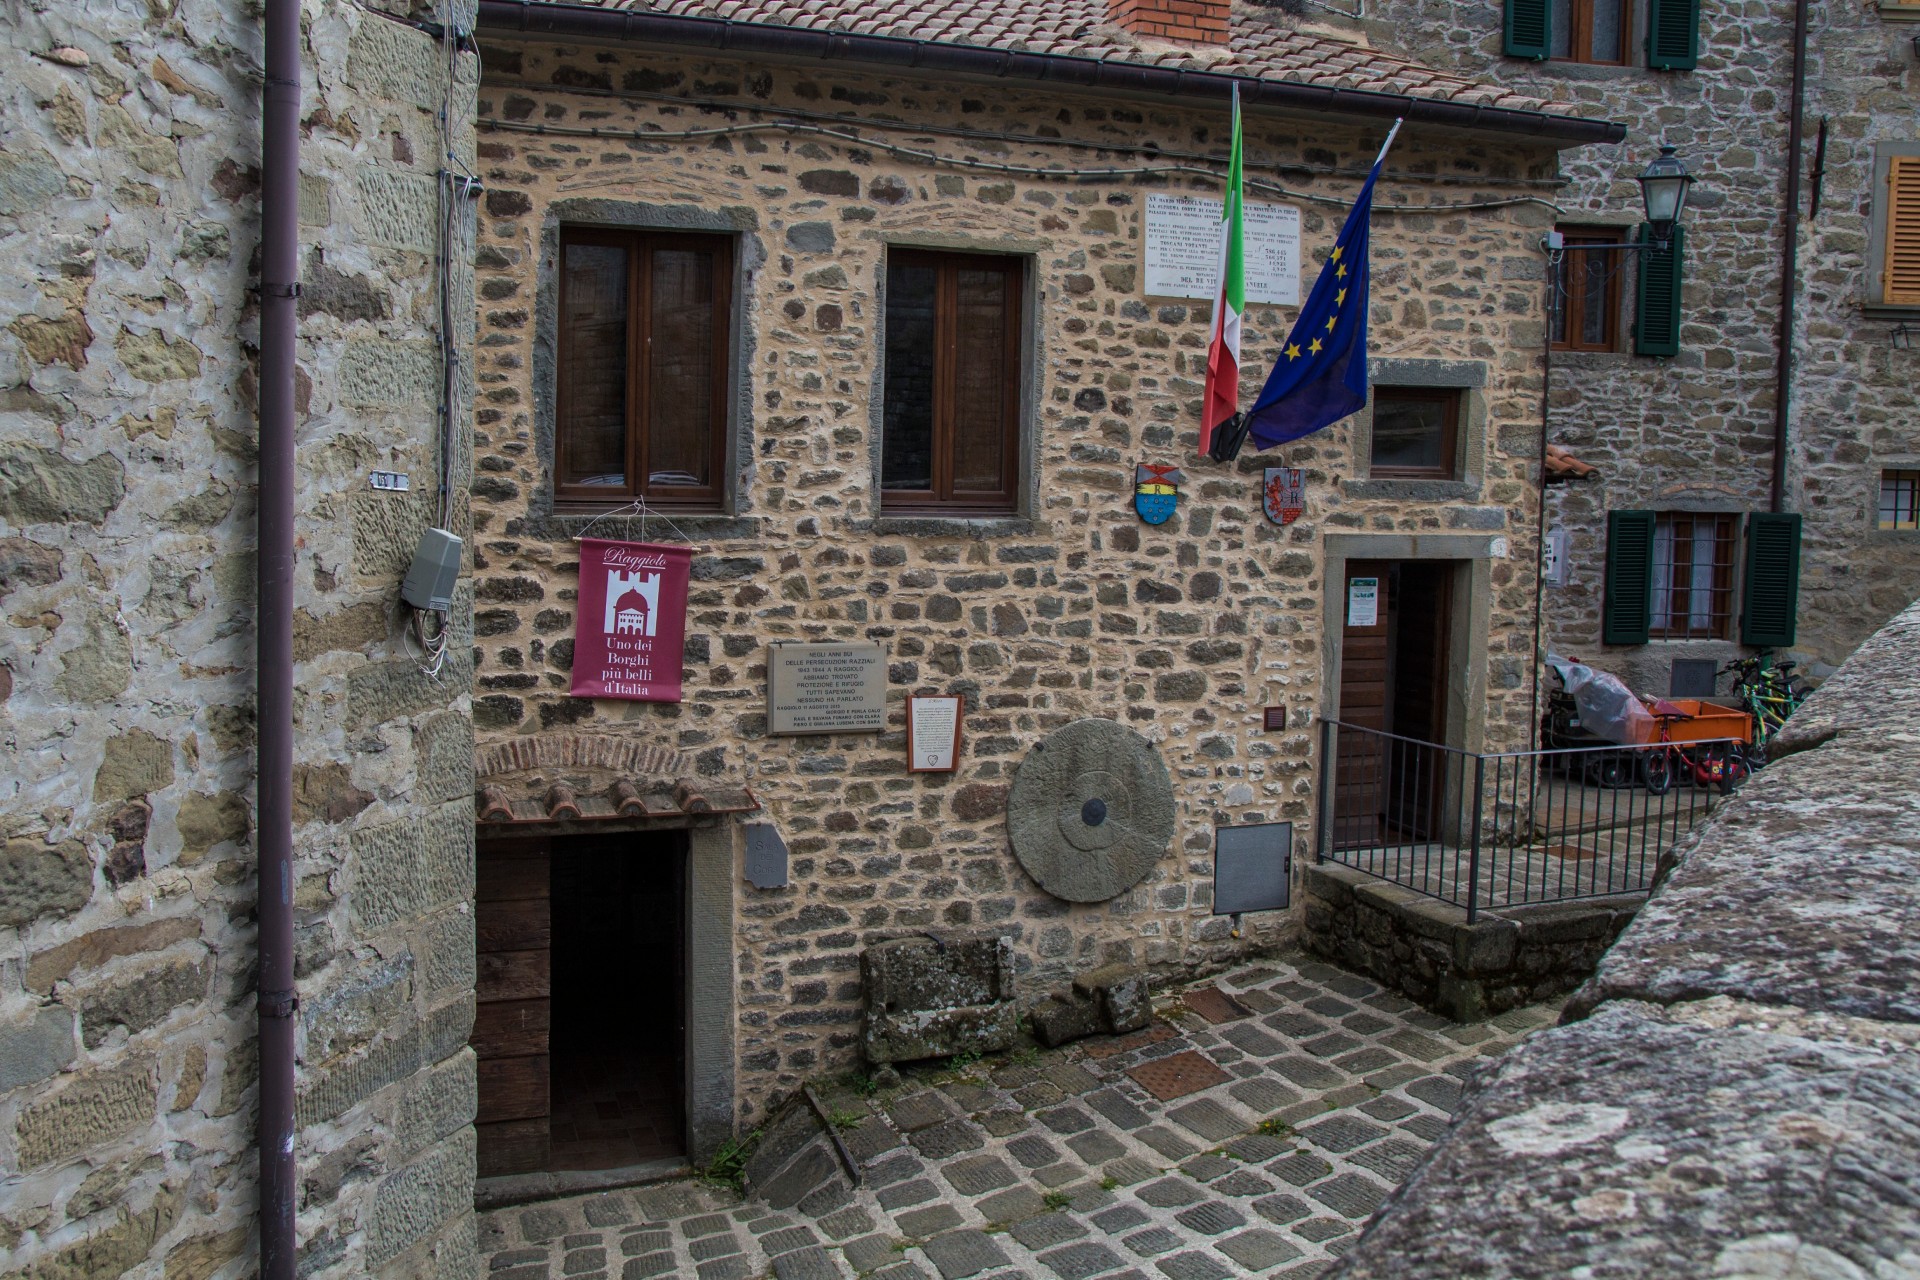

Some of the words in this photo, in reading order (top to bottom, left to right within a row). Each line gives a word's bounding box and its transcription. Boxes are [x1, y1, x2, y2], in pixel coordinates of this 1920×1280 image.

[1155, 485, 1161, 494] R
[603, 547, 667, 571] Raggiolo
[606, 637, 631, 650] Uno
[634, 639, 652, 651] dei
[607, 652, 649, 667] Borghi
[602, 667, 621, 681] più
[625, 668, 652, 681] belli
[604, 680, 649, 695] d'Italia
